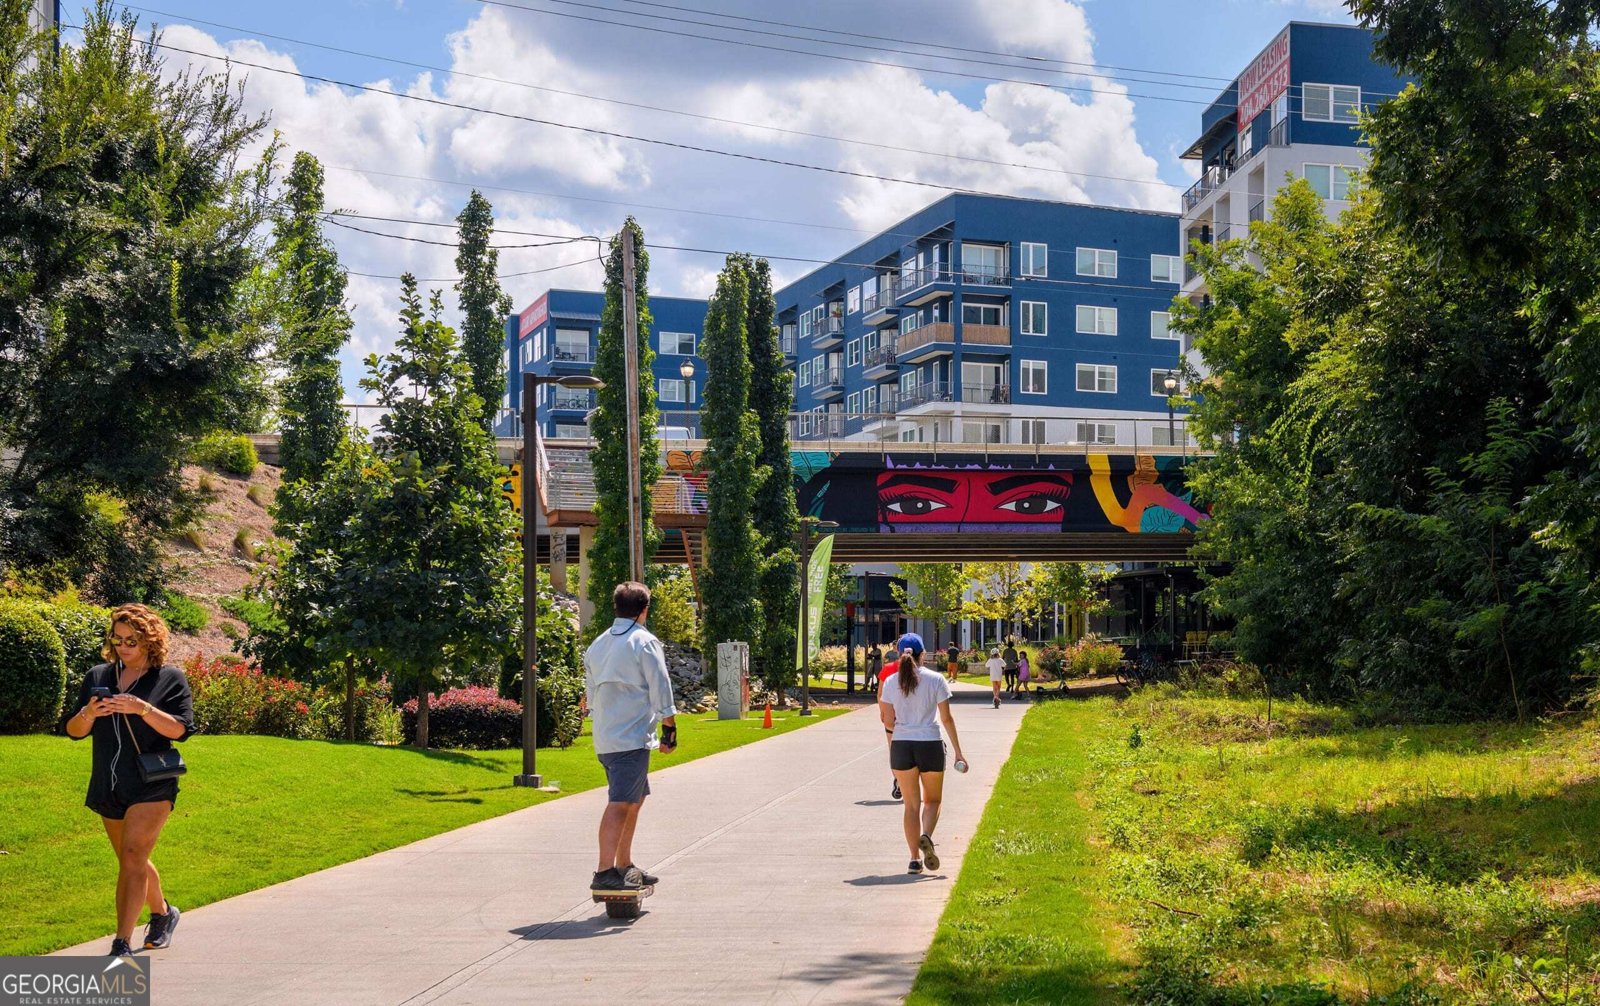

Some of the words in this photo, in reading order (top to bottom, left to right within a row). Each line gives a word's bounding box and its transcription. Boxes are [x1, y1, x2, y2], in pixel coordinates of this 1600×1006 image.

[1240, 64, 1258, 100] NOW
[1258, 34, 1288, 80] LEASING
[813, 565, 824, 593] FREE
